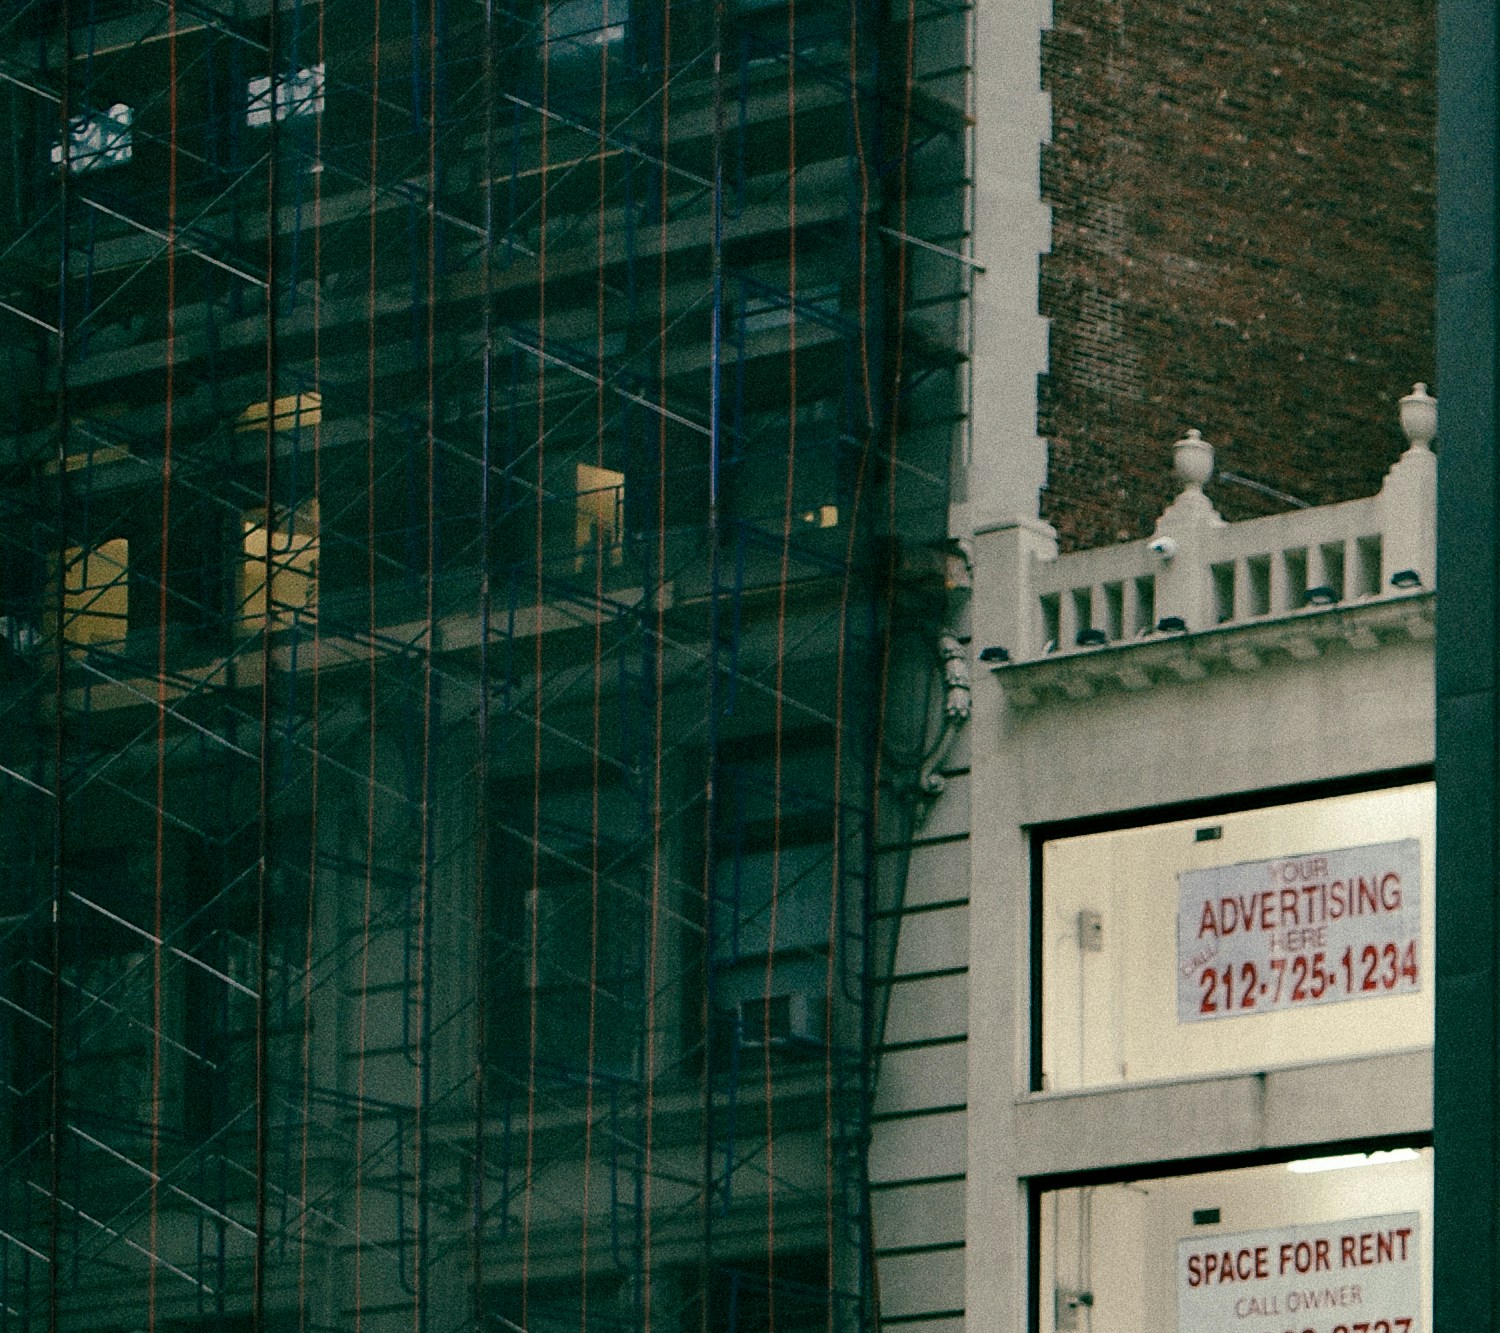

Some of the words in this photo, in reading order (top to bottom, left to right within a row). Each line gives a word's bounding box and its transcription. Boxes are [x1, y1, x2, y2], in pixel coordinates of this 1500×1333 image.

[1269, 857, 1328, 881] YOUR
[1200, 874, 1400, 939] ADVERTISING
[1270, 924, 1327, 951] HERE
[1187, 1250, 1269, 1288] SPACE
[1279, 1239, 1328, 1274] FOR
[1341, 1228, 1413, 1263] RENT
[1235, 1294, 1289, 1319] CALL
[1289, 1283, 1364, 1312] OWNER
